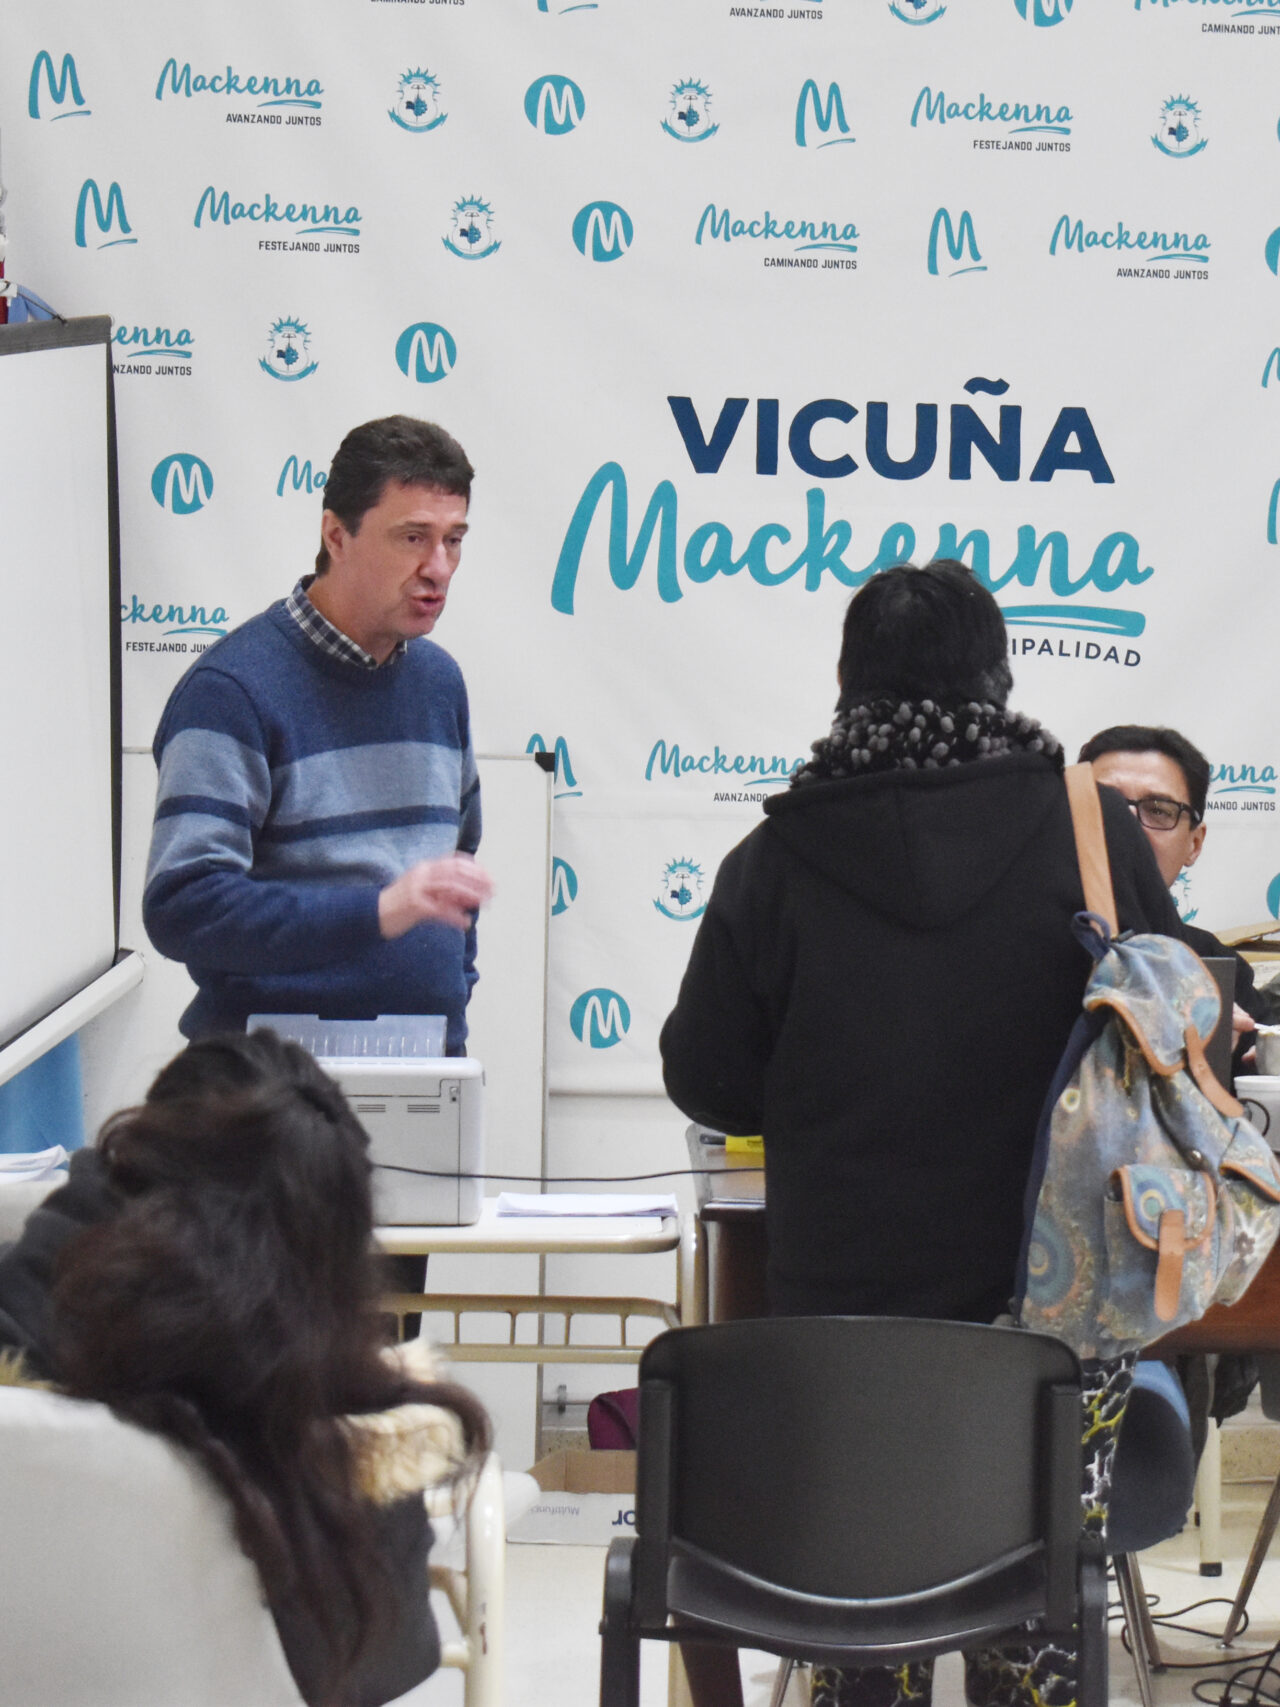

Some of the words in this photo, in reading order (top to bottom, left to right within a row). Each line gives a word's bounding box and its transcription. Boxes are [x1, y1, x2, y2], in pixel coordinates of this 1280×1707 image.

[729, 7, 785, 19] AVANZANDO
[787, 9, 823, 20] JUNTOS
[1201, 23, 1255, 35] CAMINANDO
[28, 50, 85, 119] M
[155, 58, 324, 100] Mackenna
[795, 79, 849, 147] M
[910, 86, 1073, 127] Mackenna
[225, 113, 282, 125] AVANZANDO
[285, 115, 322, 127] JUNTOS
[973, 139, 1033, 151] FESTEJANDO
[1035, 141, 1071, 153] JUNTOS
[75, 179, 131, 248] M
[194, 186, 362, 228] Mackenna
[695, 204, 859, 245] Mackenna
[1049, 215, 1211, 256] Mackenna
[258, 240, 321, 252] FESTEJANDO
[323, 243, 360, 254] JUNTOS
[927, 207, 982, 276] M
[763, 257, 819, 269] CAMINANDO
[821, 259, 858, 270] JUNTOS
[1116, 267, 1171, 279] AVANZANDO
[1173, 269, 1209, 280] JUNTOS
[111, 326, 194, 347] enna
[112, 364, 152, 375] NZANDO
[154, 365, 192, 377] JUNTOS
[667, 376, 1115, 484] VICUÑA
[551, 461, 1154, 616] Mackenna
[120, 594, 230, 625] ckenna
[125, 641, 188, 653] FESTEJANDO
[190, 642, 210, 654] JUN
[1012, 637, 1142, 667] IPALIDAD
[713, 792, 769, 803] AVANZANDO
[1206, 800, 1238, 812] NANDO
[1240, 801, 1276, 812] JUNTOS
[611, 1510, 636, 1525] or
